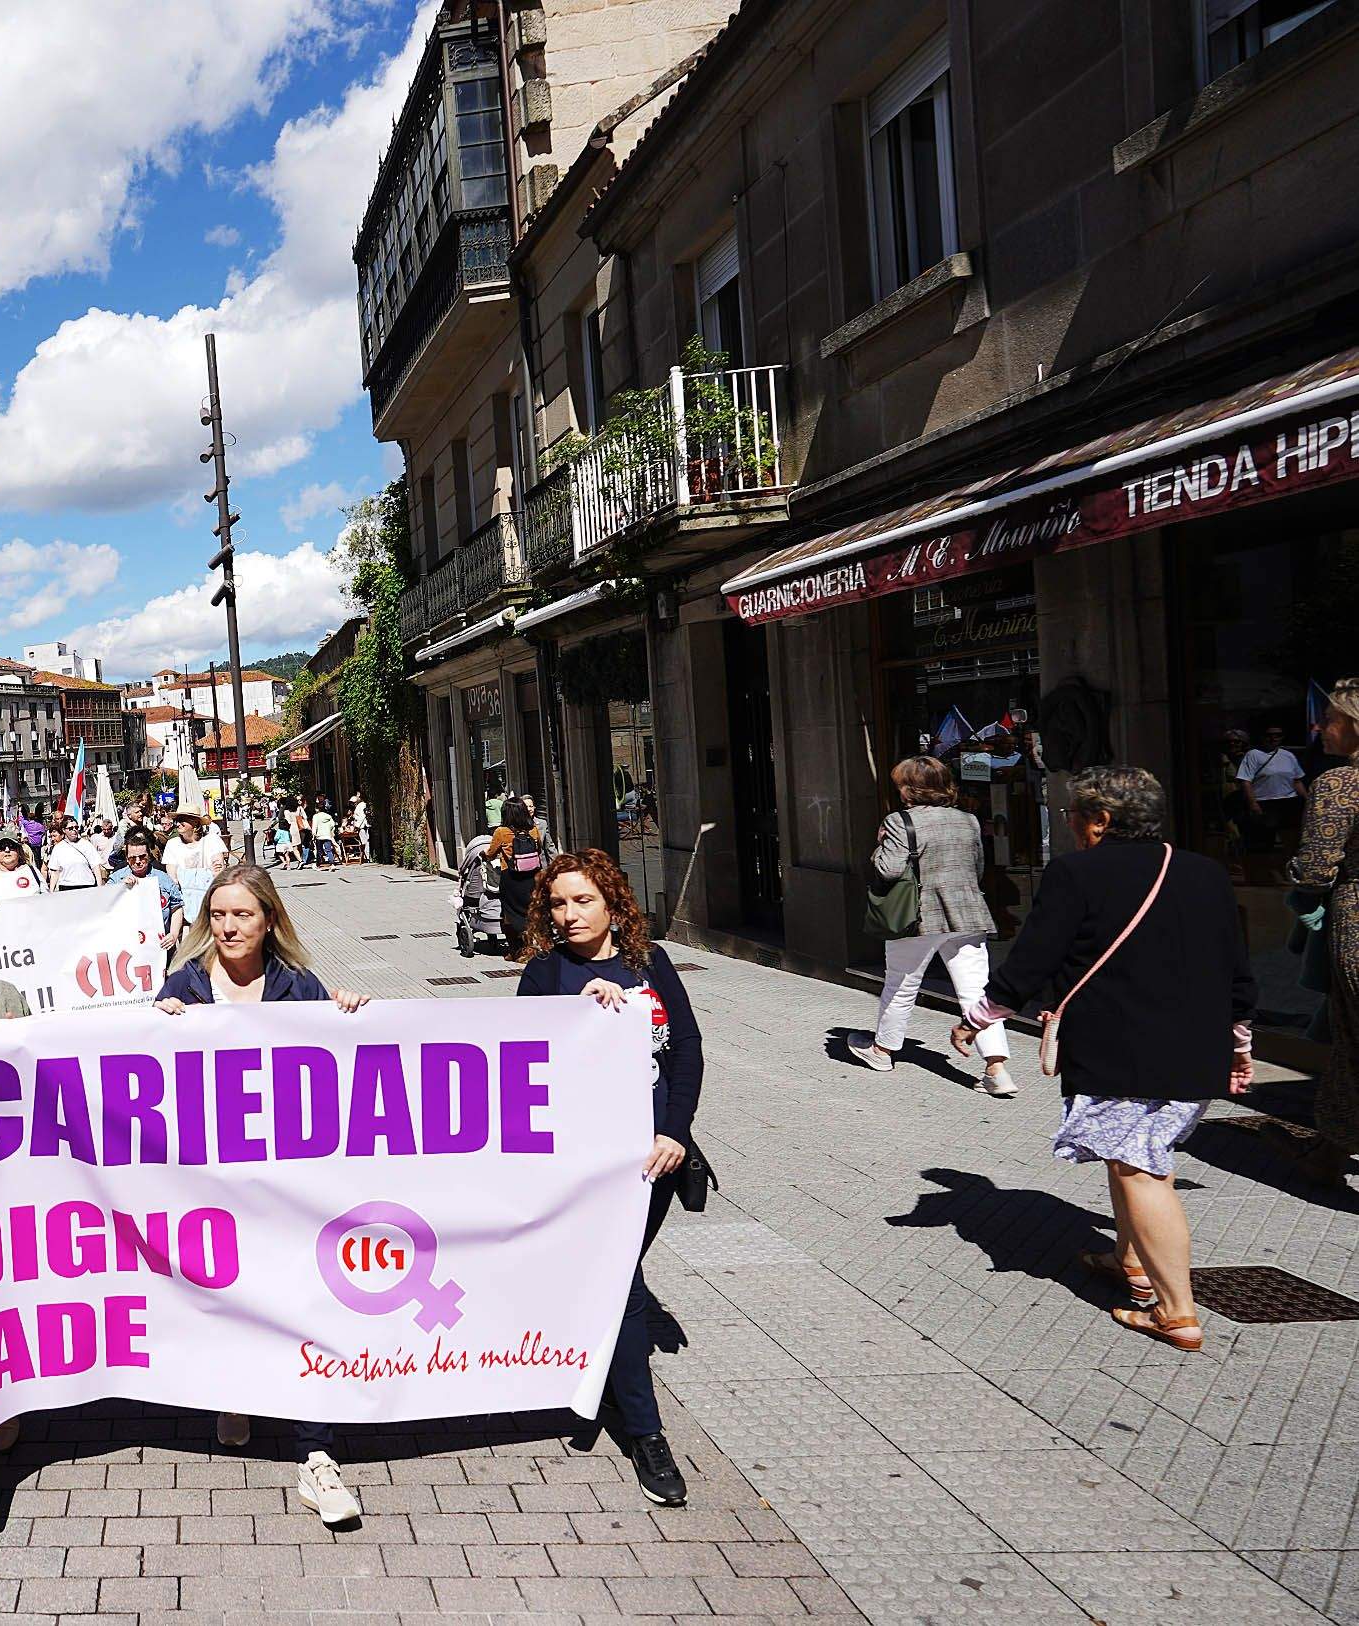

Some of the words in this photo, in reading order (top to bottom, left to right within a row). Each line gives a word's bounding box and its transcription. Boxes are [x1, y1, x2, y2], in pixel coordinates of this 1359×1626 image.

[738, 562, 867, 619] GUARNICIONERIA
[964, 499, 1082, 560] Mouriño
[1122, 444, 1260, 518] TIENDA
[76, 950, 152, 998] CIG
[342, 1237, 404, 1271] CIG
[299, 1341, 418, 1382] Secretaría
[426, 1335, 469, 1374] das
[478, 1330, 589, 1370] mulleres
